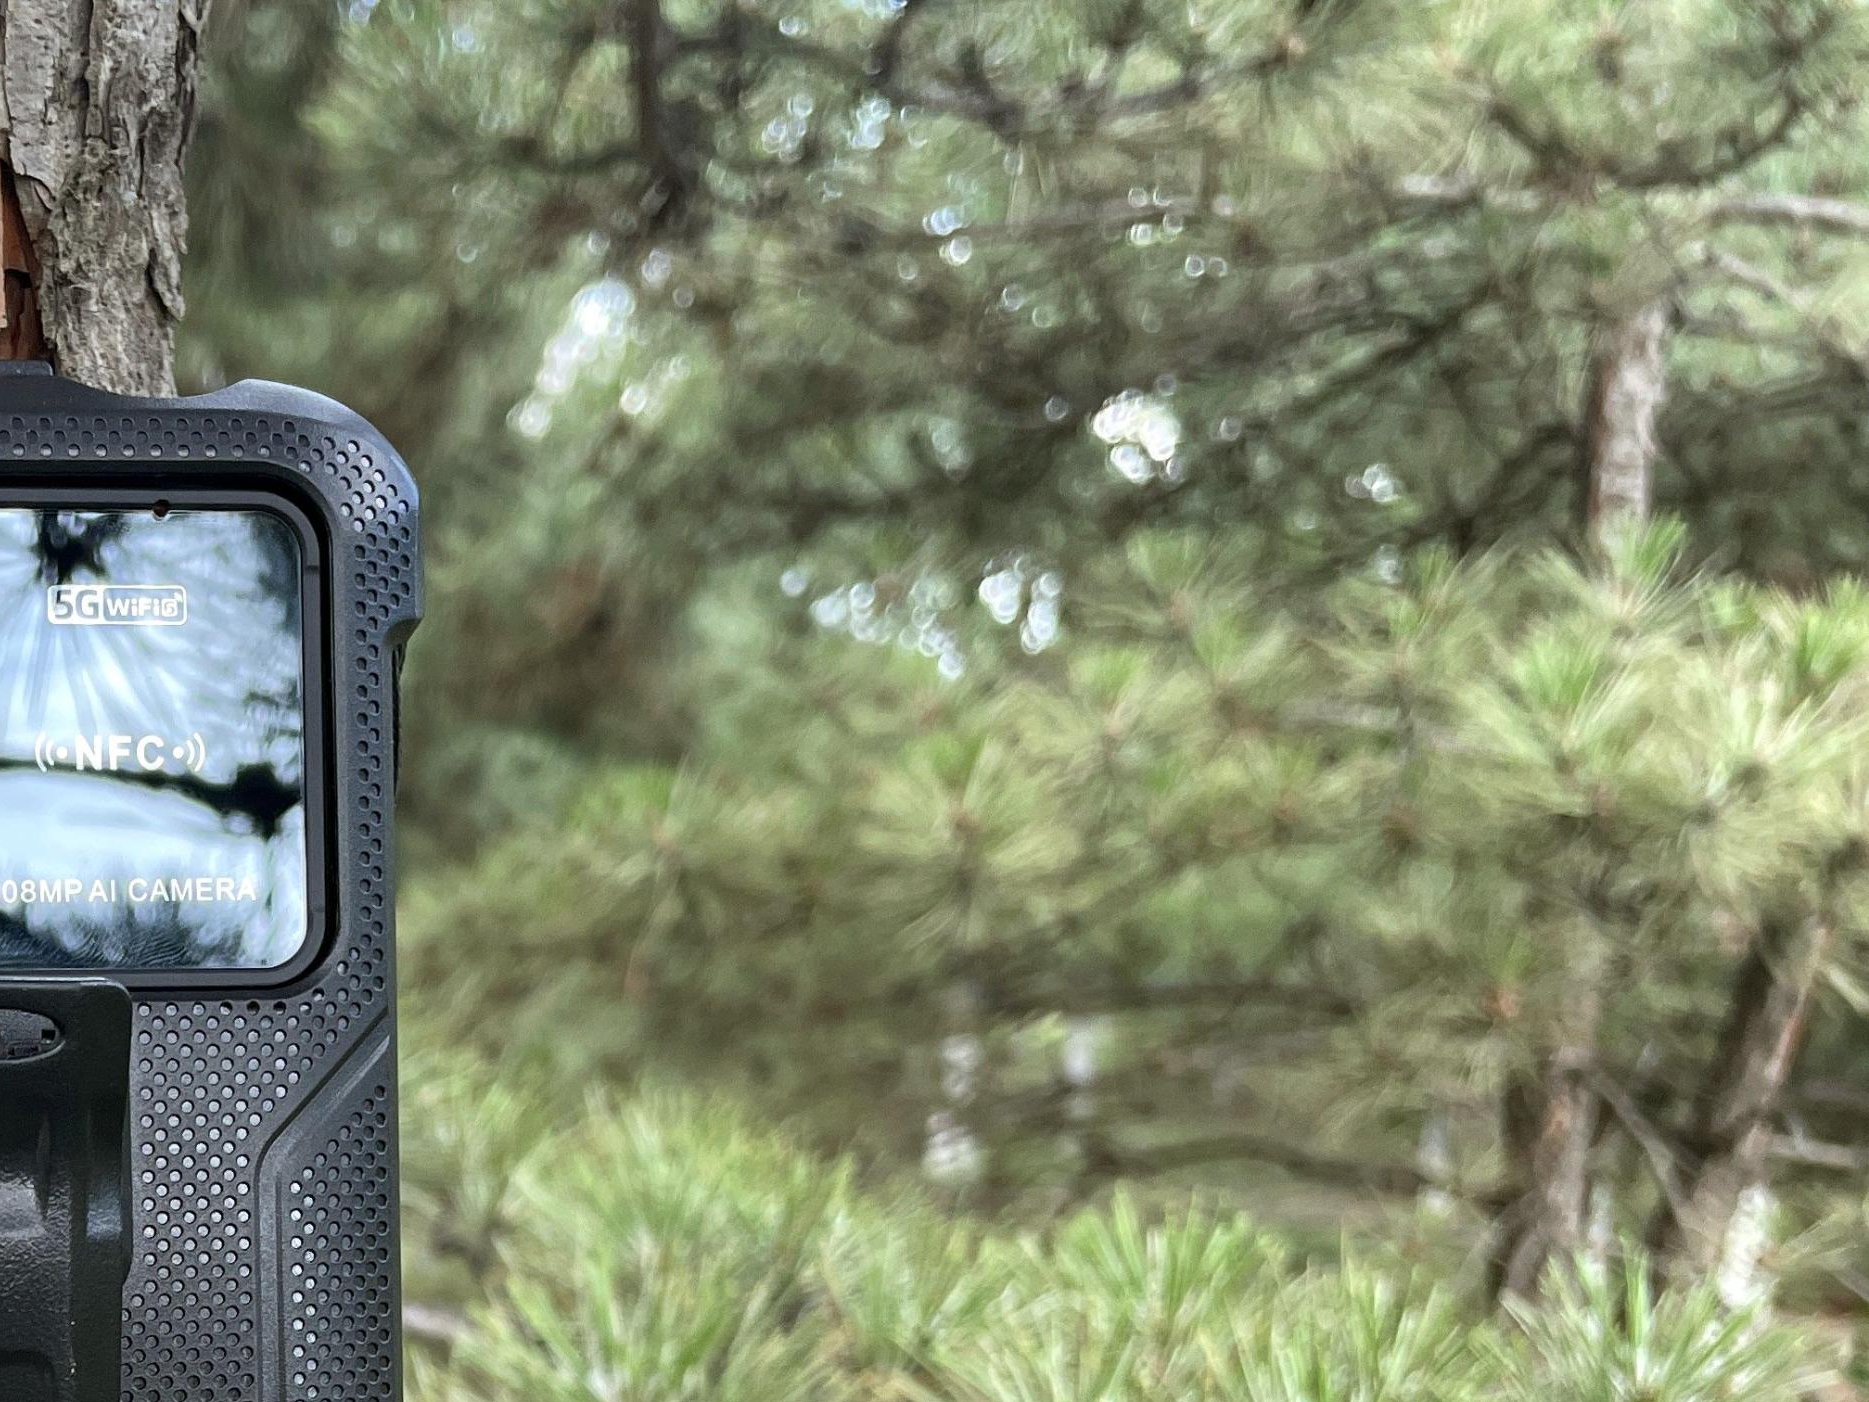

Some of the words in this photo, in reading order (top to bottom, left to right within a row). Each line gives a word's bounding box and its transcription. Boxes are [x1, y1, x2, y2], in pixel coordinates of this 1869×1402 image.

[54, 588, 100, 619] 5G
[73, 734, 165, 771] NFC
[88, 879, 117, 902] AI
[127, 877, 257, 902] CAMERA
